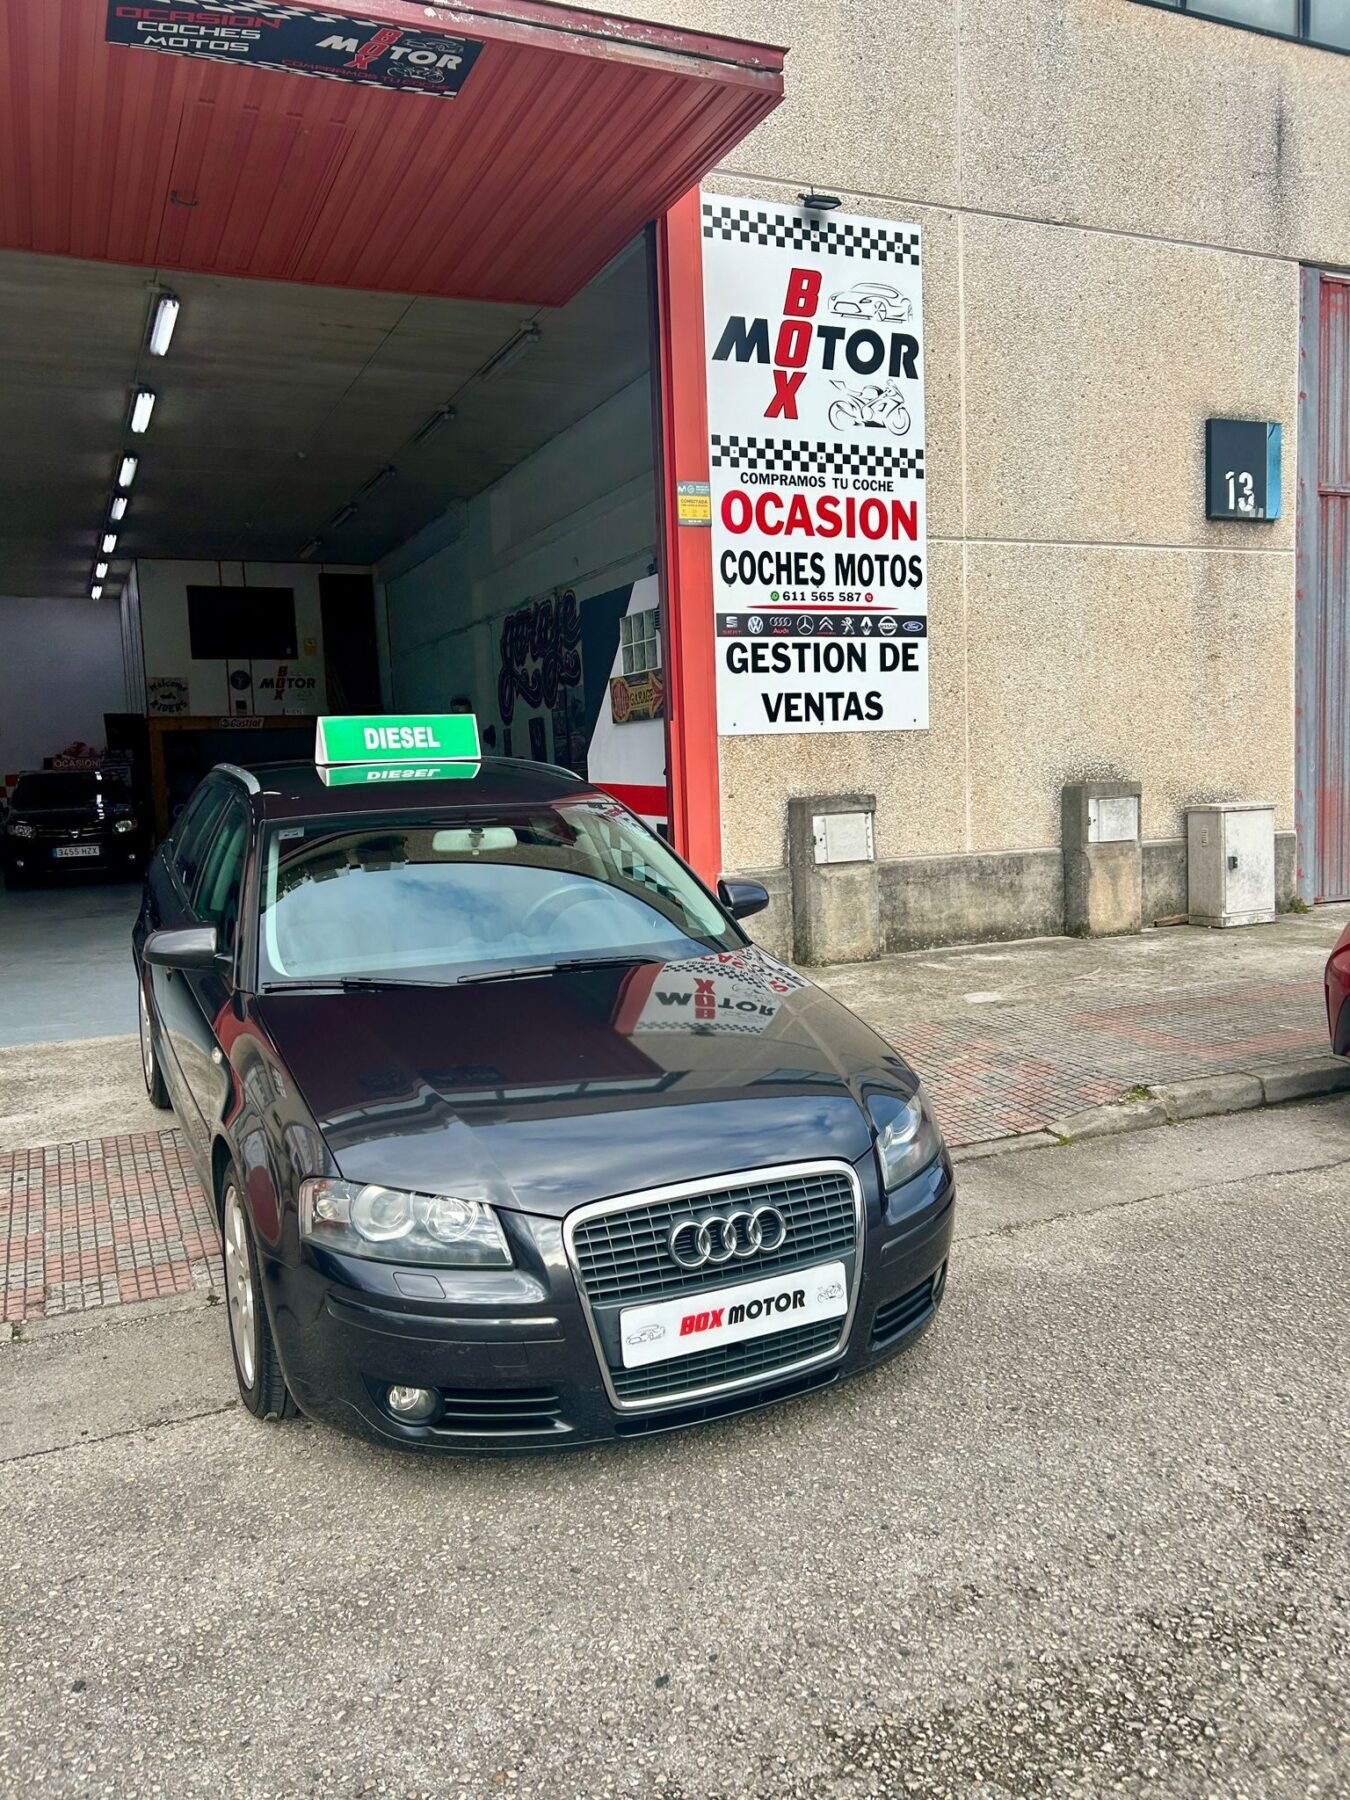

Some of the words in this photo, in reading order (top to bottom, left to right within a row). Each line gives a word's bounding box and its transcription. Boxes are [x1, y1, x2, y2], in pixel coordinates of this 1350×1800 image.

[116, 6, 281, 29] OCASION
[137, 21, 261, 40] COCHES
[144, 35, 250, 52] MOTOS
[316, 35, 463, 70] MOTOR
[348, 27, 404, 70] BOX
[712, 315, 920, 380] MOTOR
[764, 268, 822, 420] BOX
[740, 472, 826, 488] COMPRAMOS
[832, 477, 849, 490] TU
[852, 478, 894, 493] COCHE
[1225, 471, 1255, 511] 13
[720, 489, 918, 541] OCASION
[720, 550, 826, 587] COCHES
[835, 553, 923, 588] MOTOS
[782, 591, 806, 602] 611
[810, 591, 835, 602] 565
[838, 592, 862, 602] 587
[726, 642, 866, 673] GESTION
[879, 642, 919, 672] DE
[259, 678, 316, 689] MOTOR
[761, 691, 884, 723] VENTAS
[364, 726, 440, 749] DIESEL
[54, 758, 99, 768] OCASION
[680, 1307, 725, 1336] BOX
[728, 1289, 806, 1325] MOTOR
